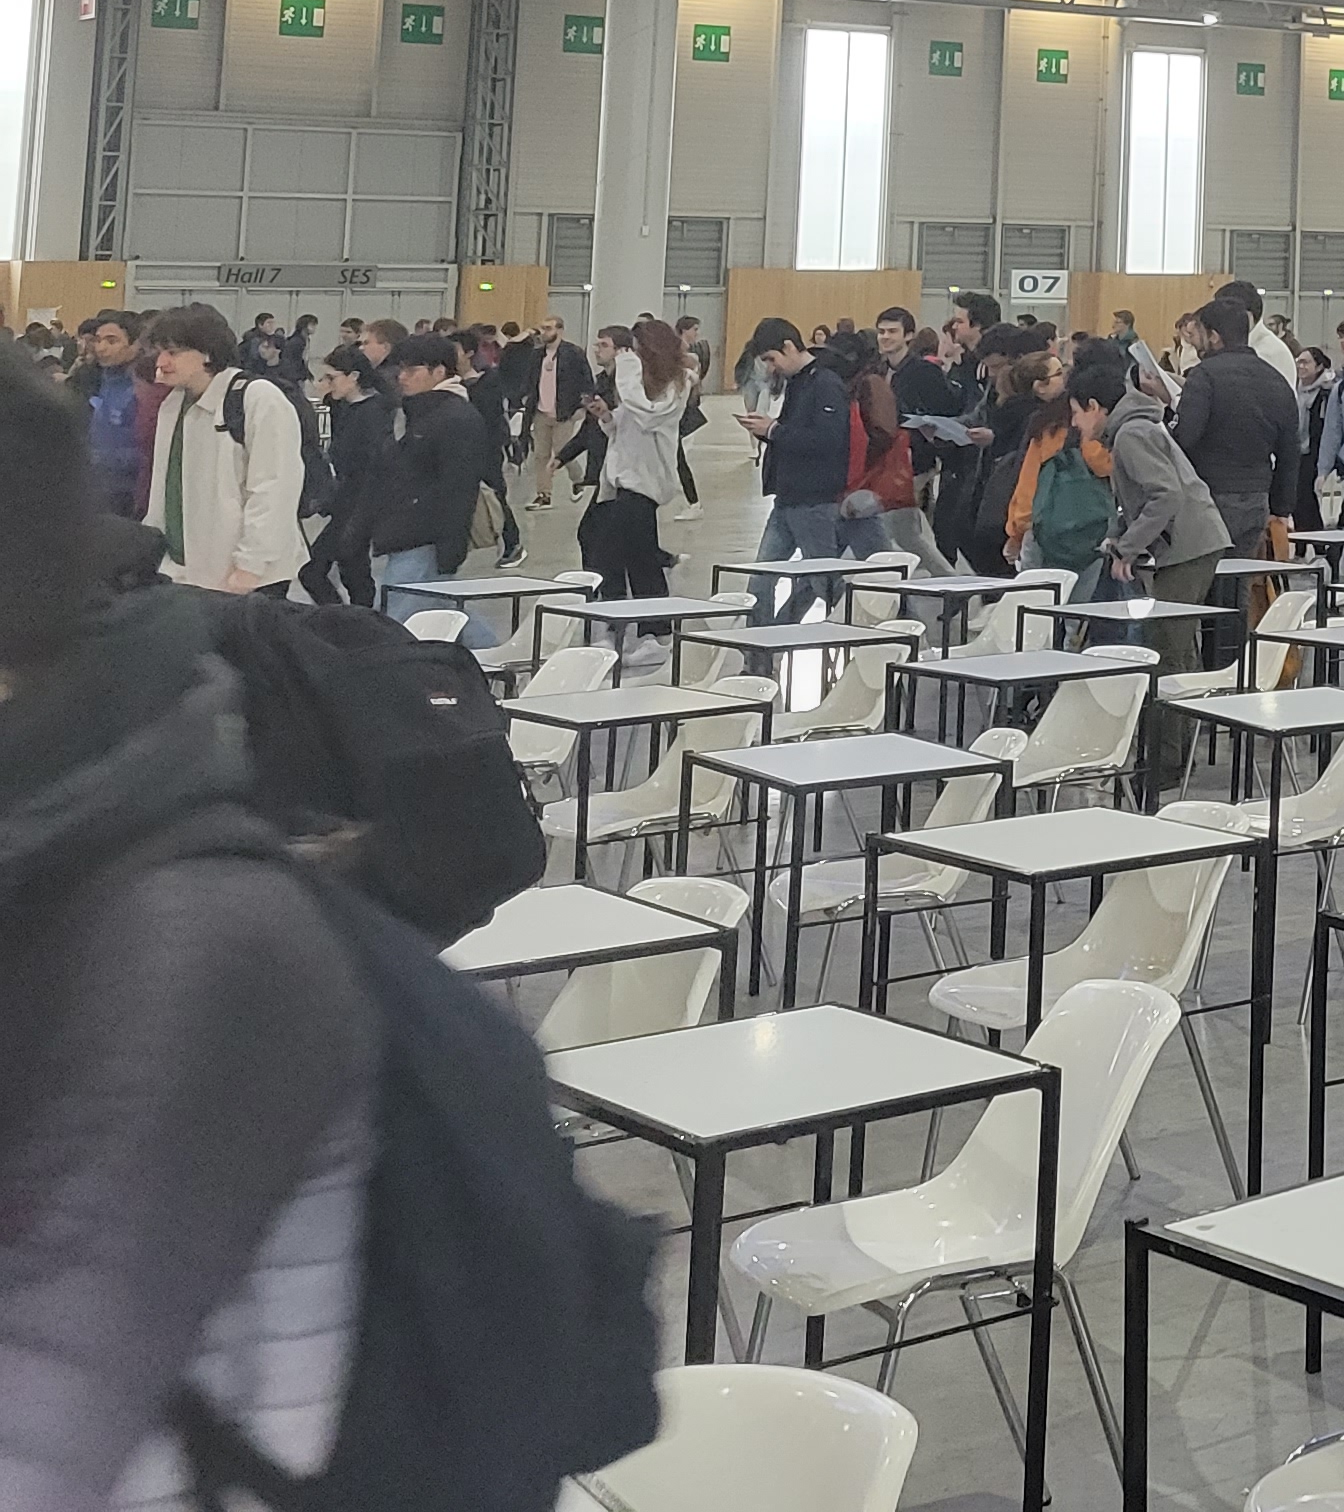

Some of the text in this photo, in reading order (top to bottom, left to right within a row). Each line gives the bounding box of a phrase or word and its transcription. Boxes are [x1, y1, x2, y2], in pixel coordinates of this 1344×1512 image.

[225, 267, 265, 284] Hall
[269, 268, 282, 284] 7
[1018, 275, 1061, 294] 07
